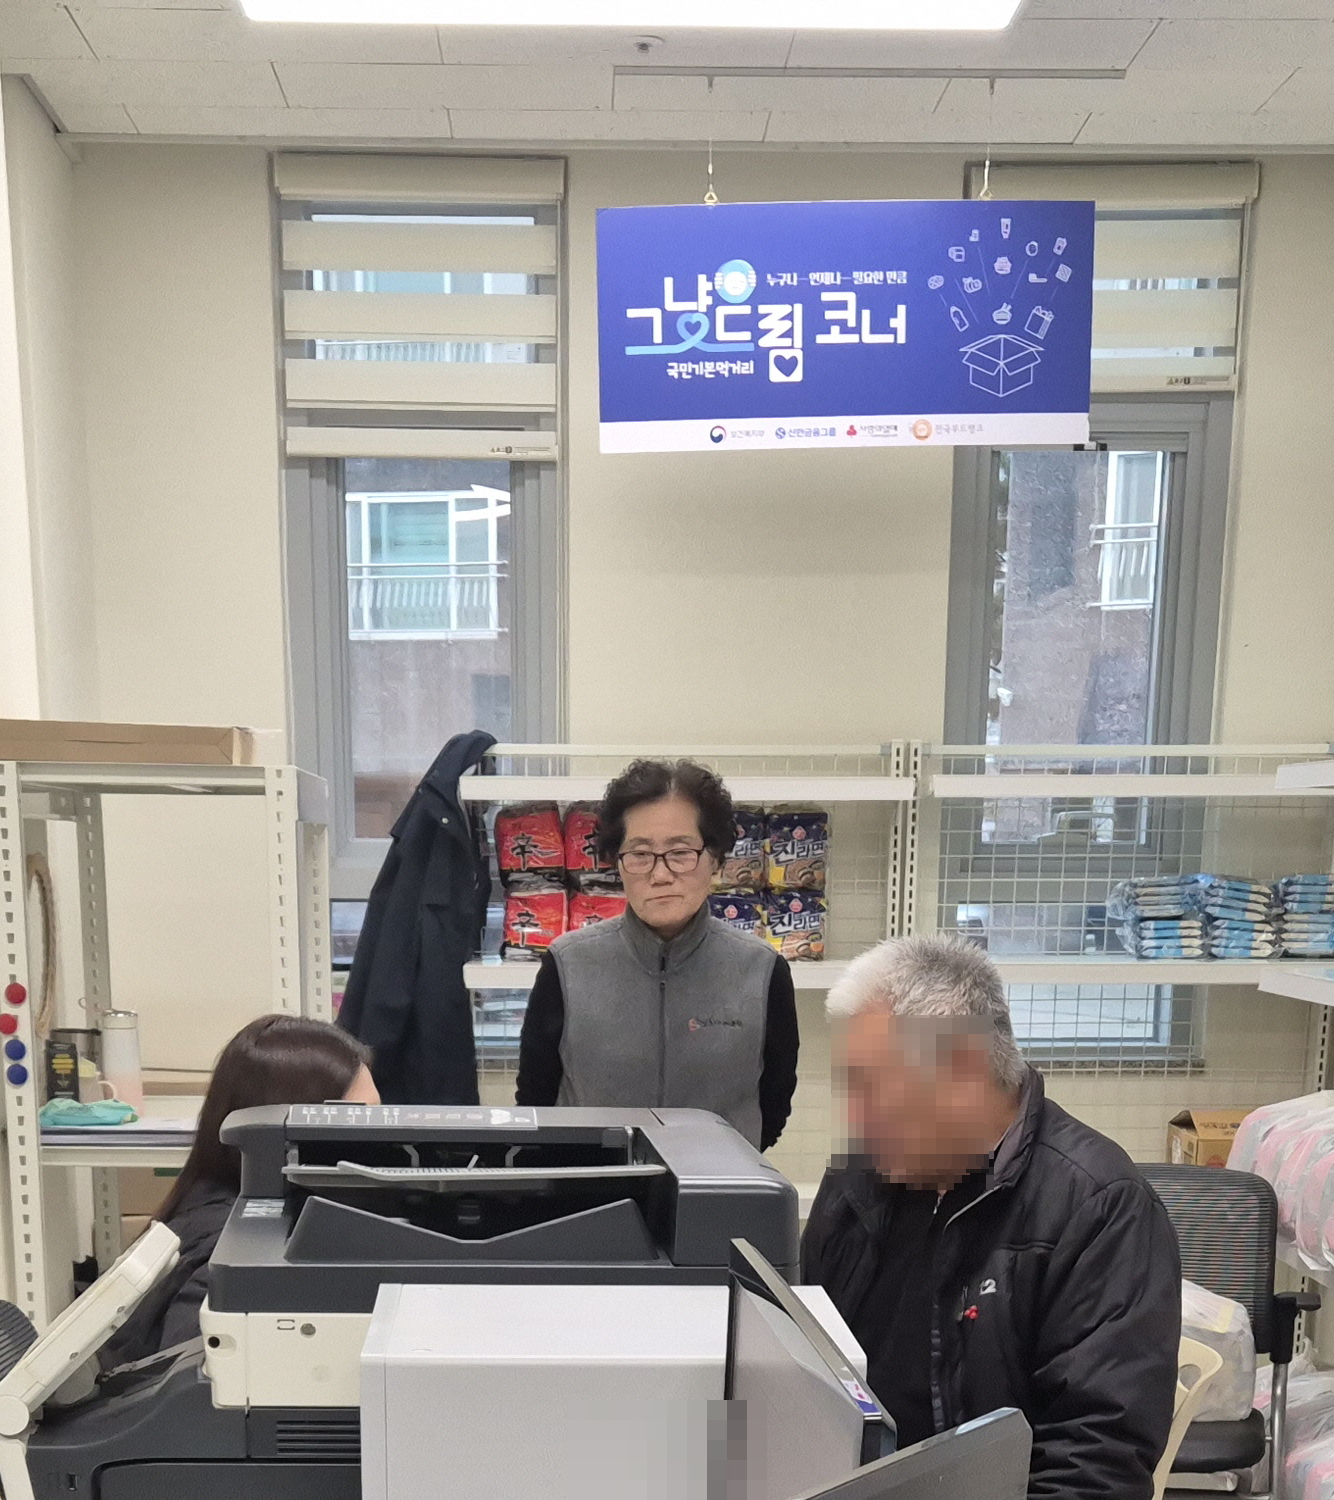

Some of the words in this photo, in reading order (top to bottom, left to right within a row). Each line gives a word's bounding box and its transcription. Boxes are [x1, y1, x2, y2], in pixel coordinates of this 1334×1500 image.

[625, 273, 803, 383] 그냥드림
[815, 291, 907, 344] 코너
[666, 360, 754, 379] 국민기본먹거리
[511, 833, 540, 871] 辛
[772, 839, 824, 864] 진라면
[770, 911, 821, 936] 진라면
